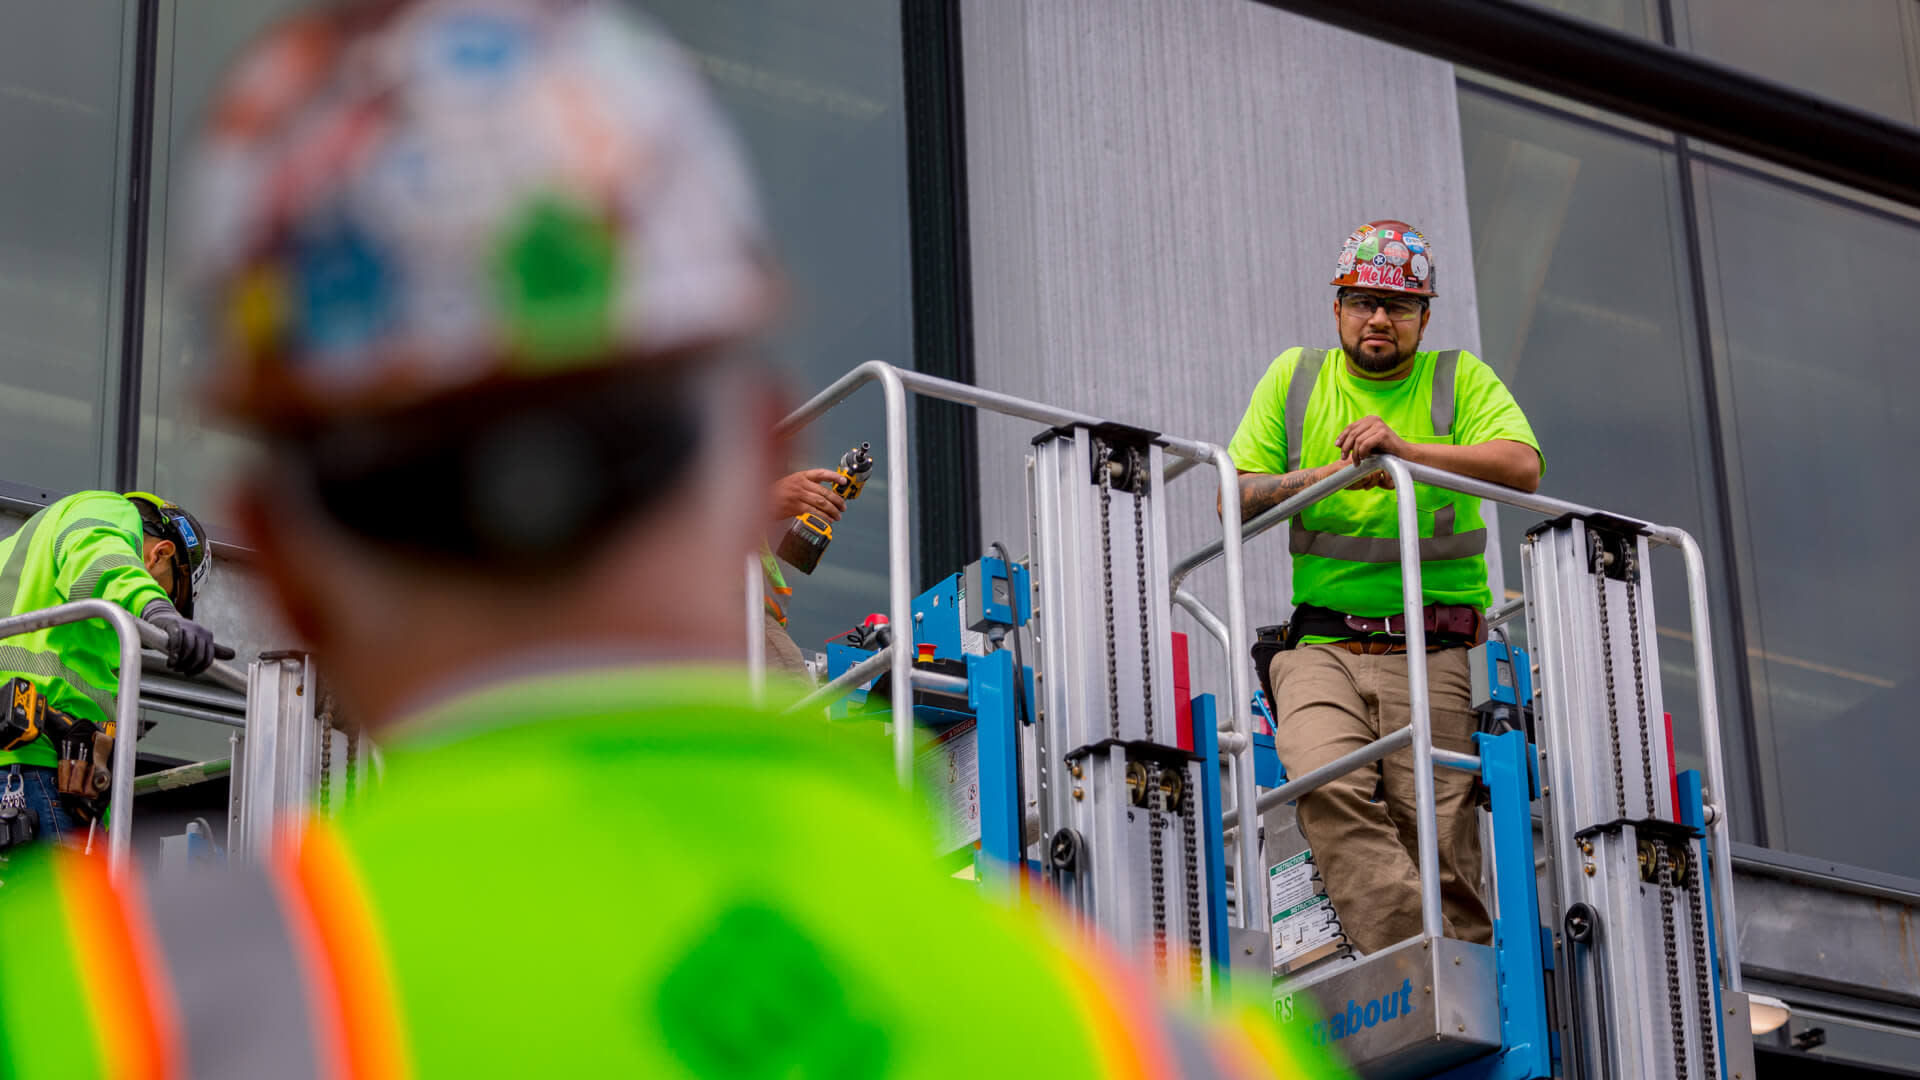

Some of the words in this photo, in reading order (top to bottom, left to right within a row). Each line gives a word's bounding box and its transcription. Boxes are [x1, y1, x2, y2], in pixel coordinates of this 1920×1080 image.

[1357, 264, 1378, 283] Me
[1377, 265, 1405, 287] Vale
[1275, 854, 1306, 873] INSTRUCTIONS
[1290, 895, 1321, 914] INSTRUCTIONS
